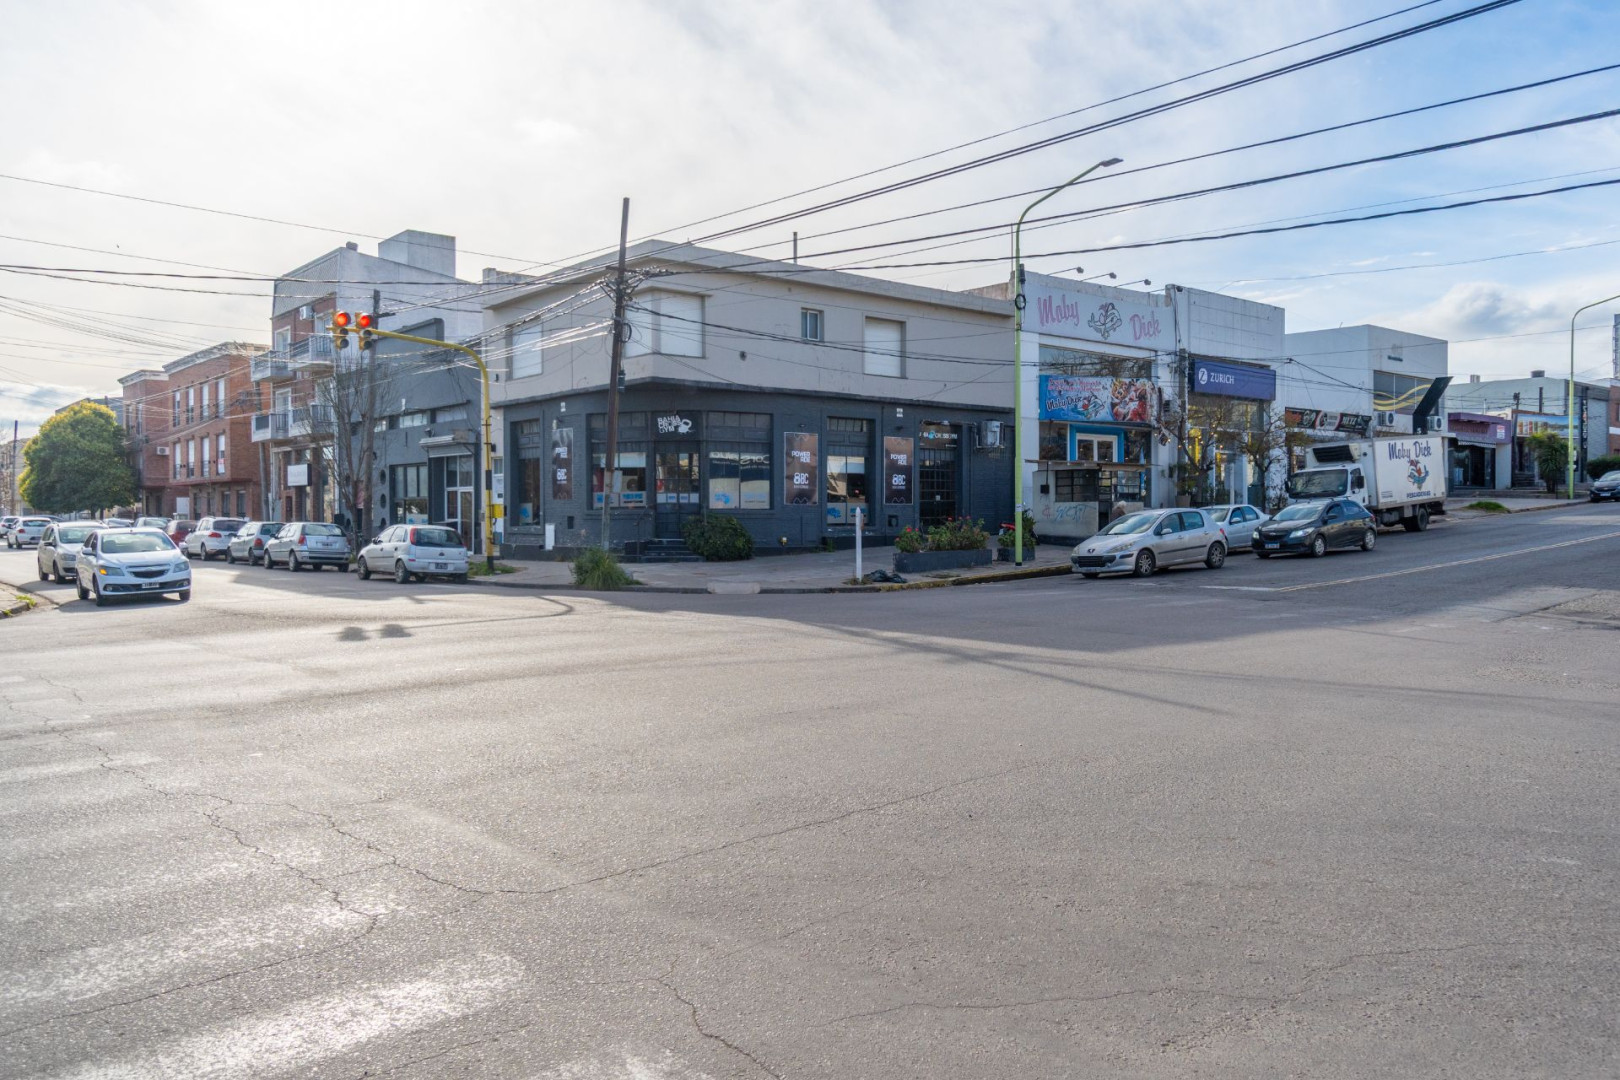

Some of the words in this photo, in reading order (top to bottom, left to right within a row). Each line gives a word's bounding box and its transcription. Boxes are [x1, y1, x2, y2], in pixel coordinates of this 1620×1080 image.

[1037, 294, 1079, 327] Moby
[1129, 310, 1161, 341] Dick
[1210, 372, 1234, 384] ZURICH
[1388, 442, 1411, 464] Moby
[1413, 440, 1432, 458] Dick
